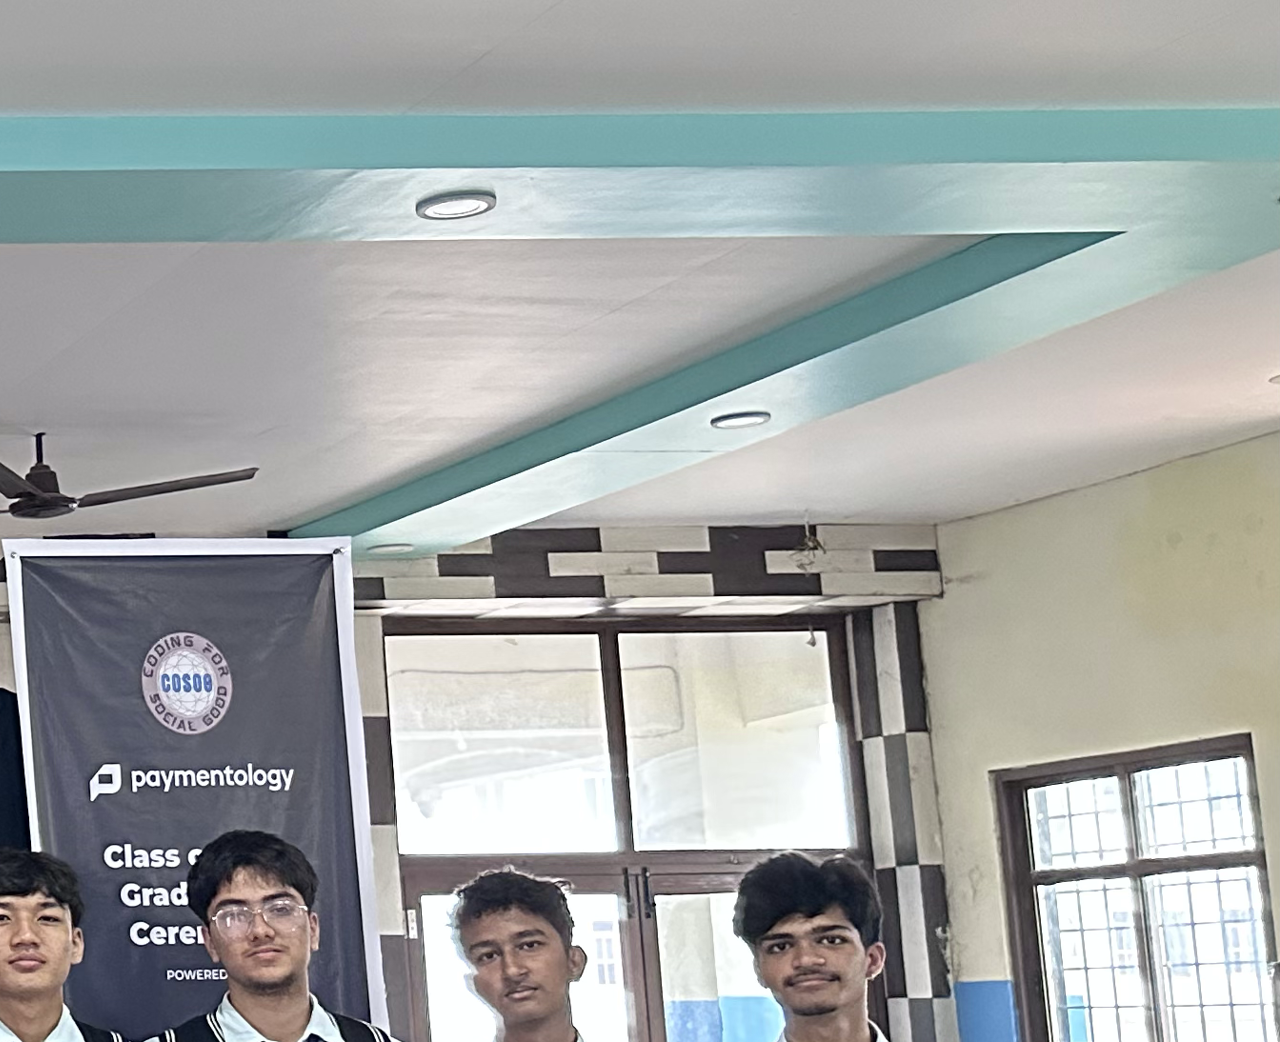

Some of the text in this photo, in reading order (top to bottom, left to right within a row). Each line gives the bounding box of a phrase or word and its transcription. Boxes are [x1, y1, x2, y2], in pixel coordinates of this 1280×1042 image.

[142, 634, 231, 679] CODING FOR
[148, 685, 229, 733] SOCIAL GOOD
[130, 762, 294, 791] paymentology
[103, 843, 181, 869] Class
[120, 881, 189, 907] Grad
[166, 968, 229, 981] POWERED
